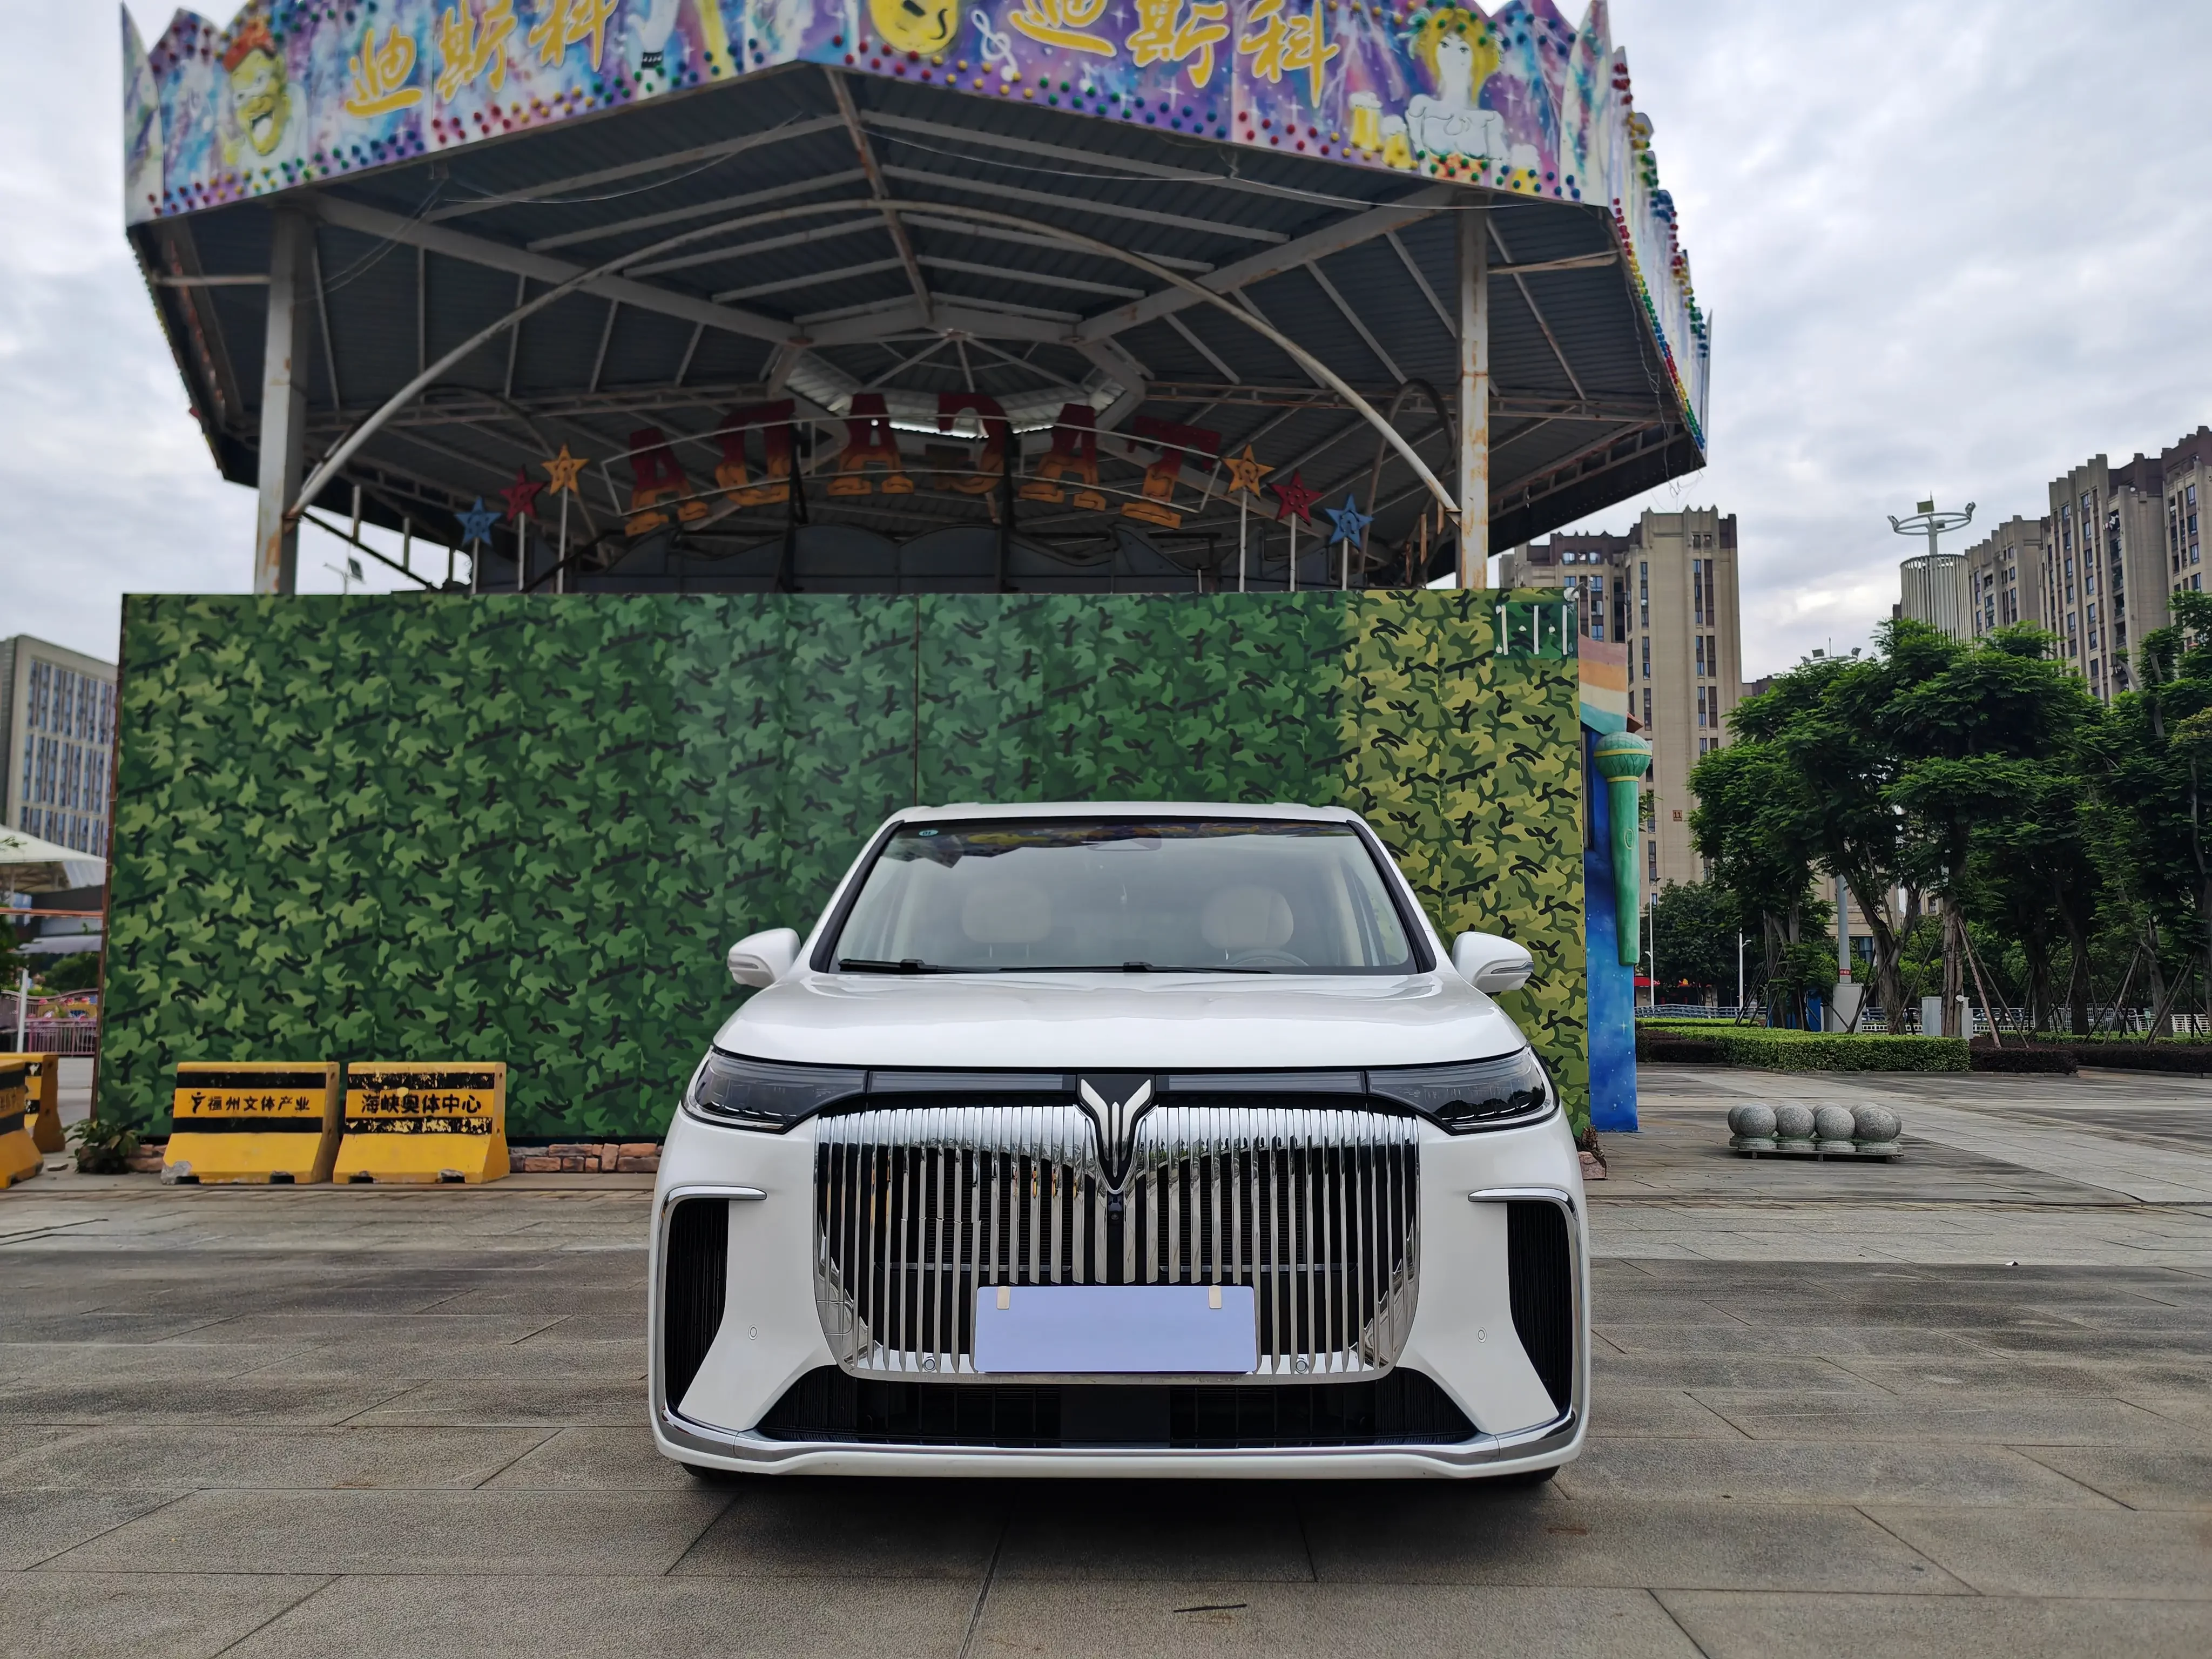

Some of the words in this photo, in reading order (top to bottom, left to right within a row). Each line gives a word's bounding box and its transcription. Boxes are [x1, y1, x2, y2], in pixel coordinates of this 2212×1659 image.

[345, 0, 618, 118] 迪斯科
[208, 1096, 310, 1111] 福州文体产业
[361, 1093, 481, 1114] 海峡奥体中心
